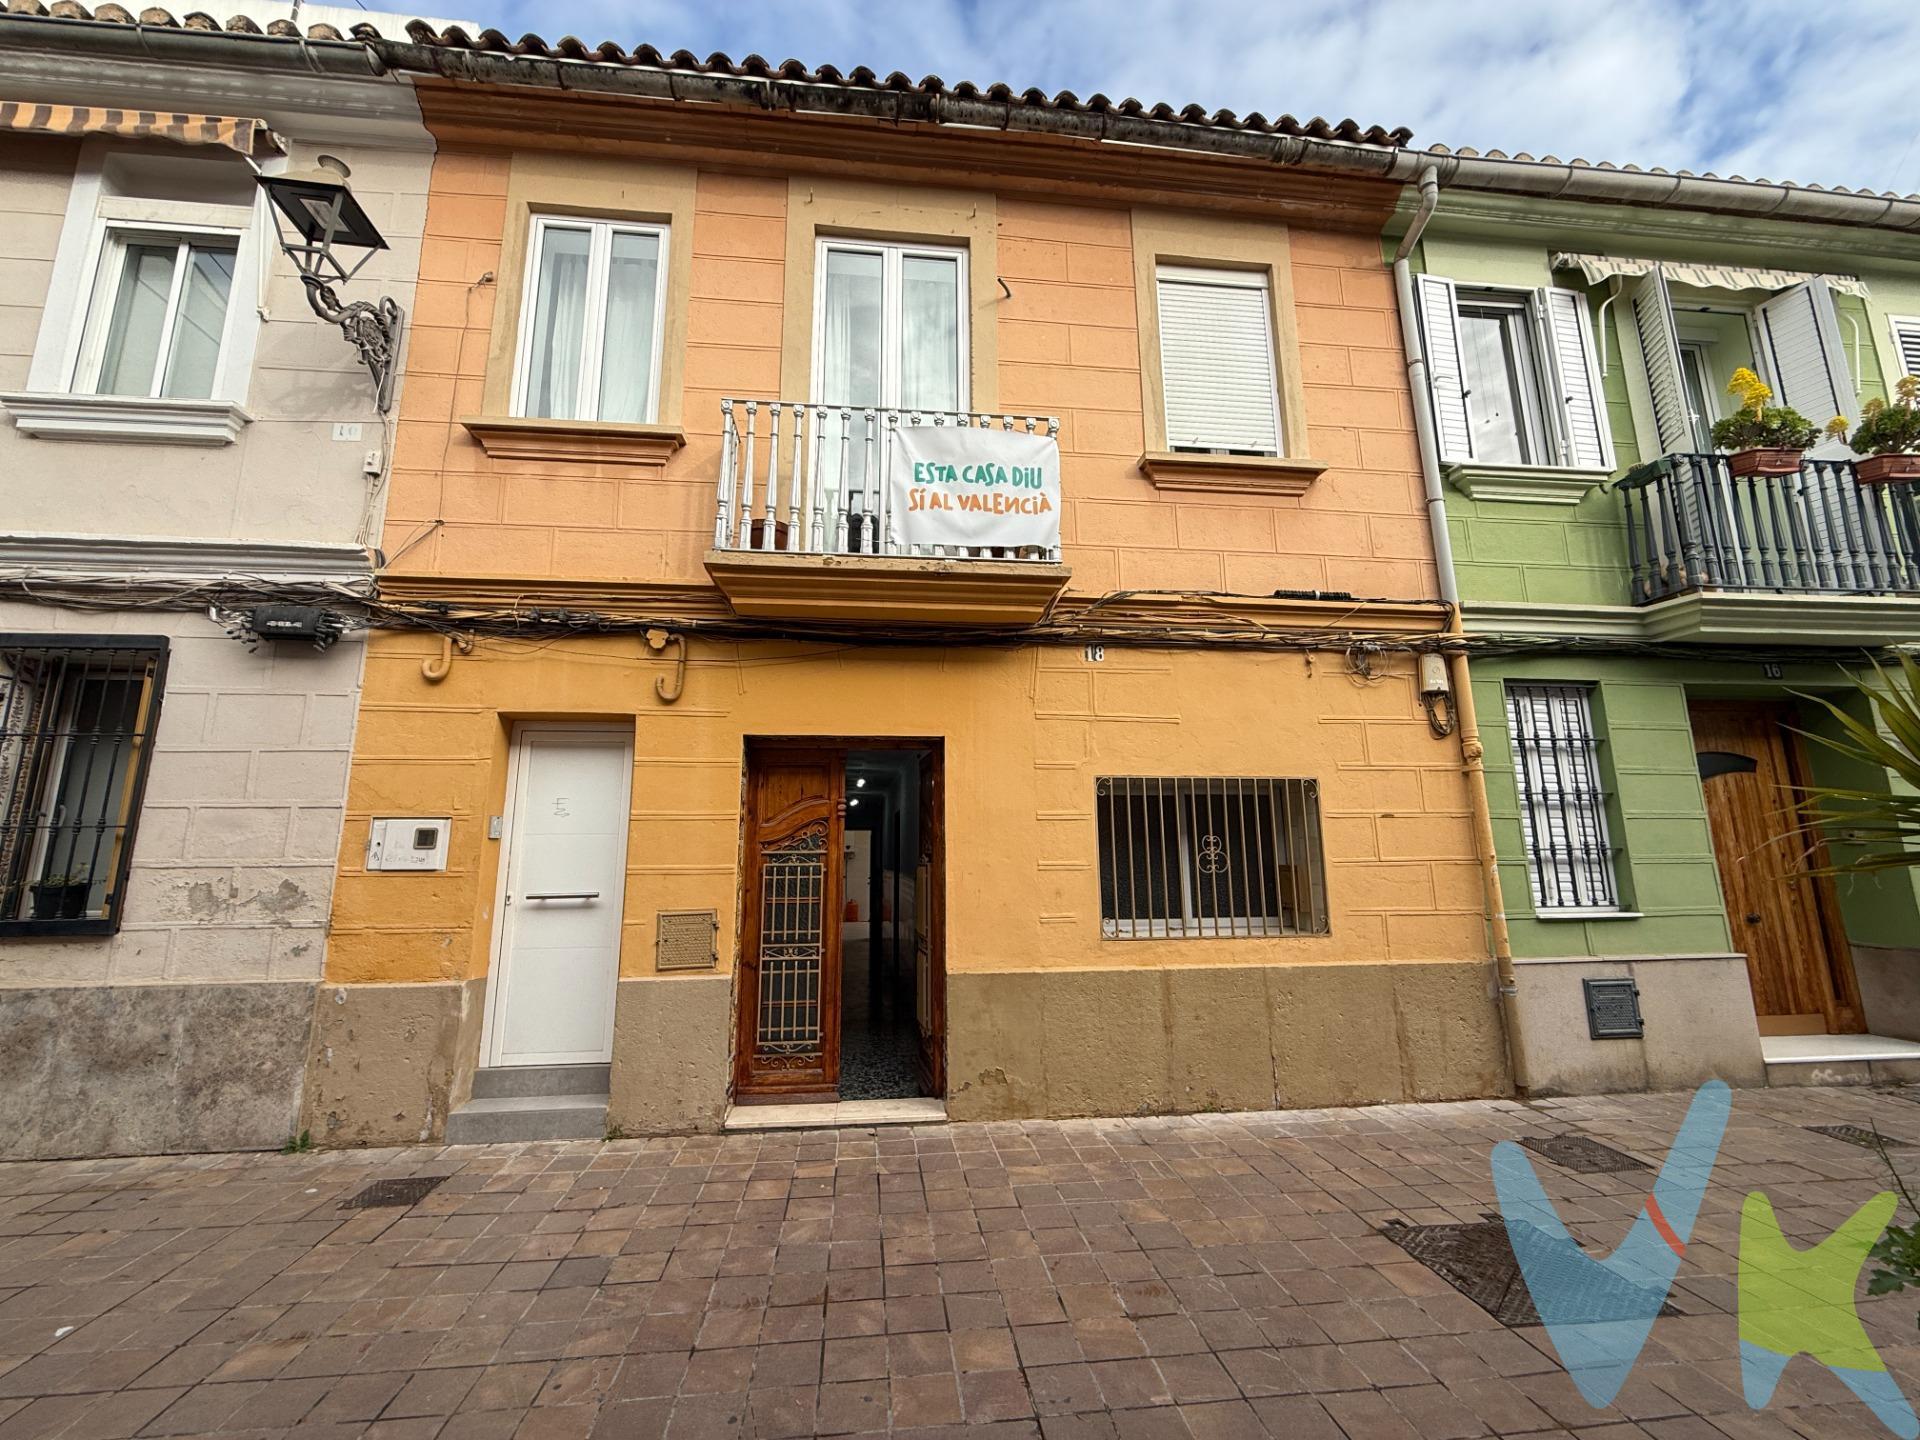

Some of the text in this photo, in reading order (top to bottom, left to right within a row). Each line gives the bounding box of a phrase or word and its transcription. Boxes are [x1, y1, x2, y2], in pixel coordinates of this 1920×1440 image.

[914, 463, 958, 484] ESTA
[962, 463, 1008, 487] CASA
[908, 488, 926, 512] SÍ
[929, 492, 954, 511] AL
[1085, 645, 1105, 662] 18
[1764, 663, 1781, 678] 16
